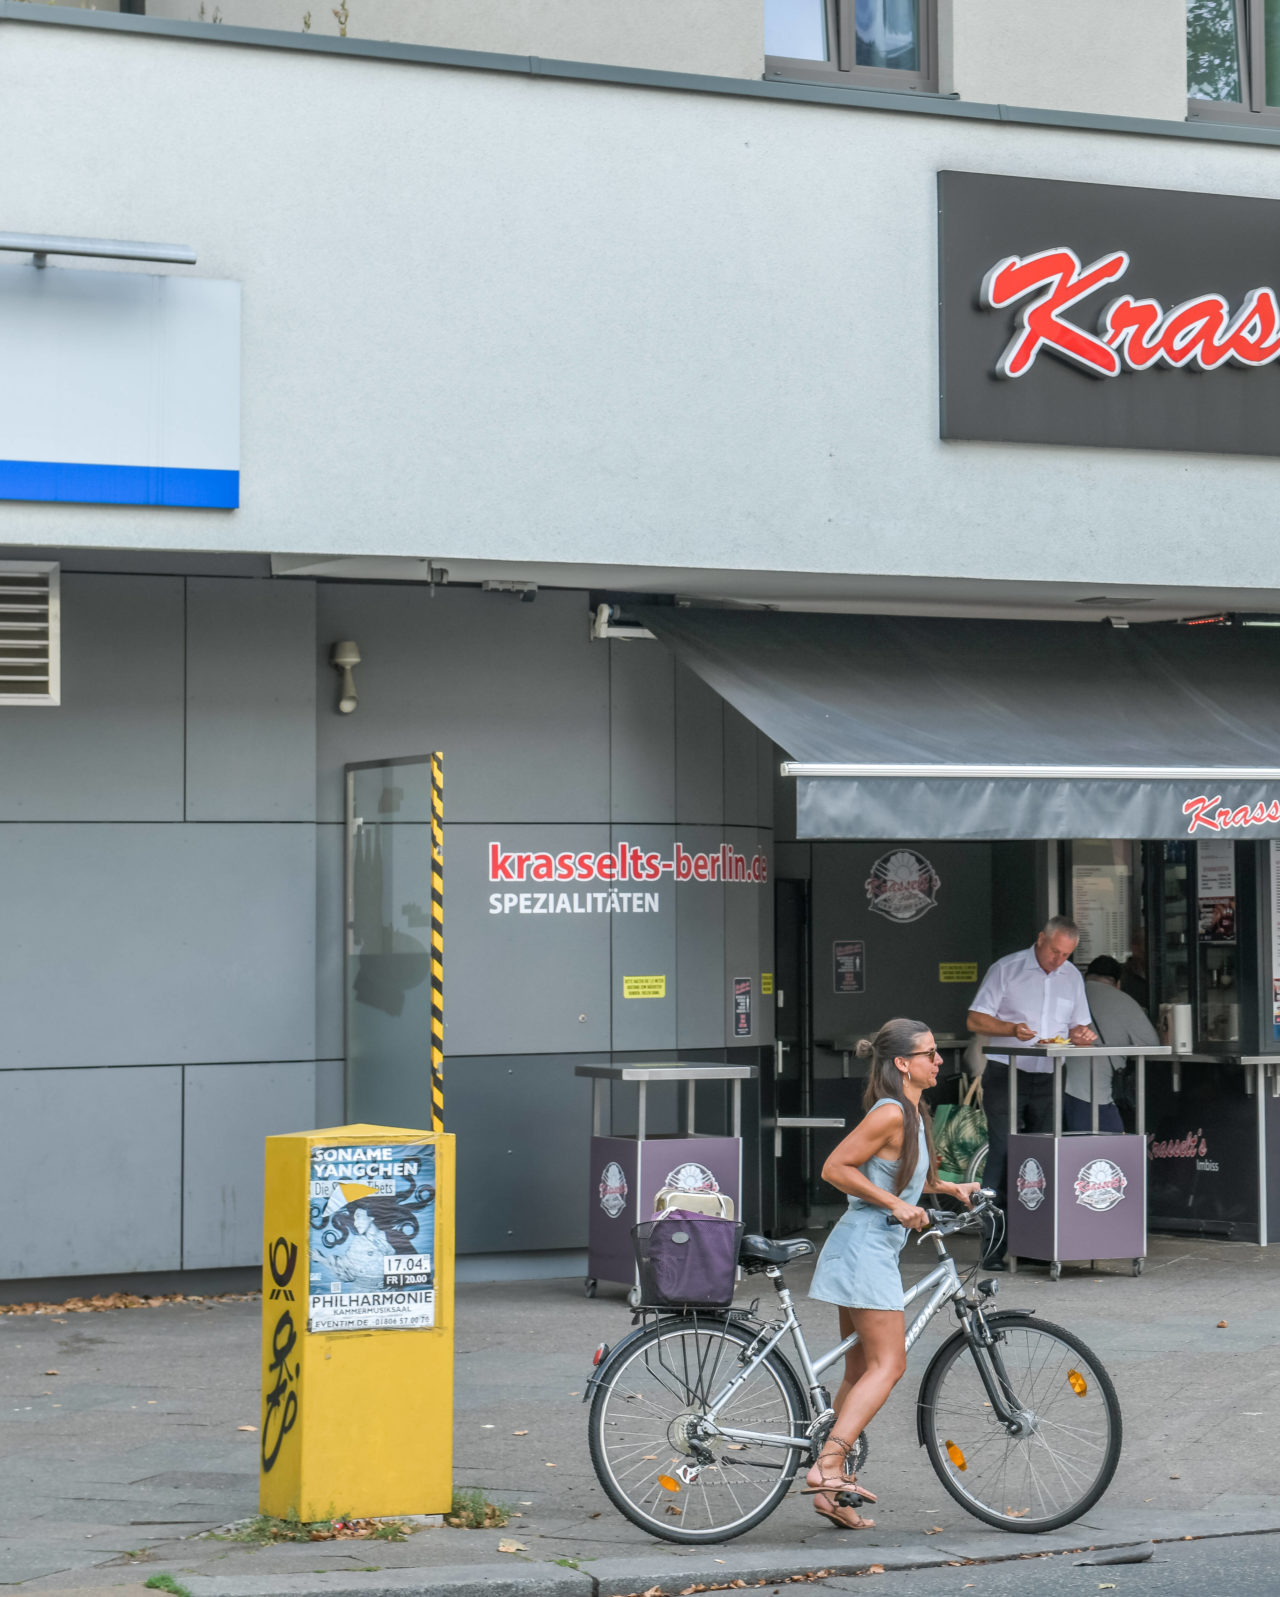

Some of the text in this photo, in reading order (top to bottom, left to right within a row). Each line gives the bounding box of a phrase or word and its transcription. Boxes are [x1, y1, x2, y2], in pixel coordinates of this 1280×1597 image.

[488, 888, 660, 915] SPEZIALITÄTEN
[313, 1148, 393, 1161] SONAME
[313, 1162, 419, 1178] YANGCHEN
[1196, 1159, 1220, 1171] Imbiss
[315, 1182, 330, 1196] Die
[387, 1258, 428, 1272] 17.04.
[386, 1274, 427, 1285] FR 20.00
[312, 1291, 433, 1309] PHILHARMONIE
[333, 1305, 412, 1316] KAMMERMUSIKSAAL
